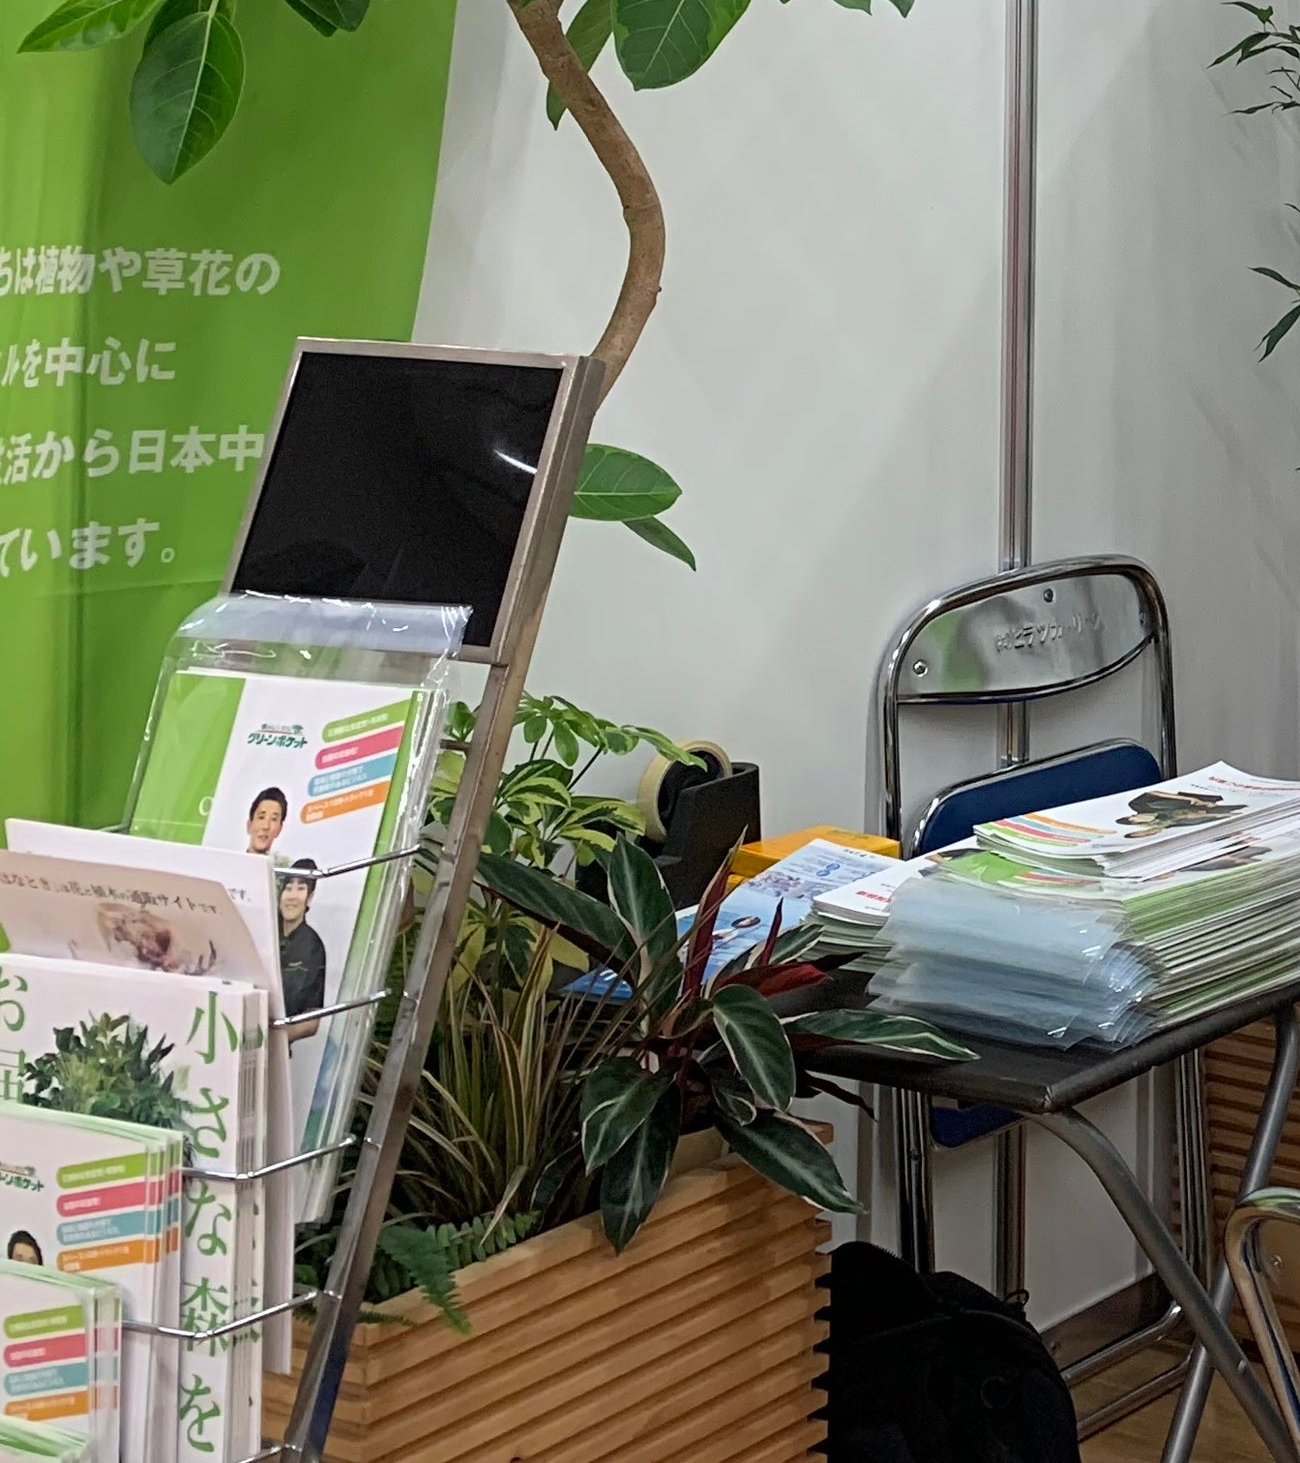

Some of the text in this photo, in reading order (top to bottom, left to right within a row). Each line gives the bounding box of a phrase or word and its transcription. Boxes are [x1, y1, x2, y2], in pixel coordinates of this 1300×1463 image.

[178, 989, 239, 1454] 小さな森を
